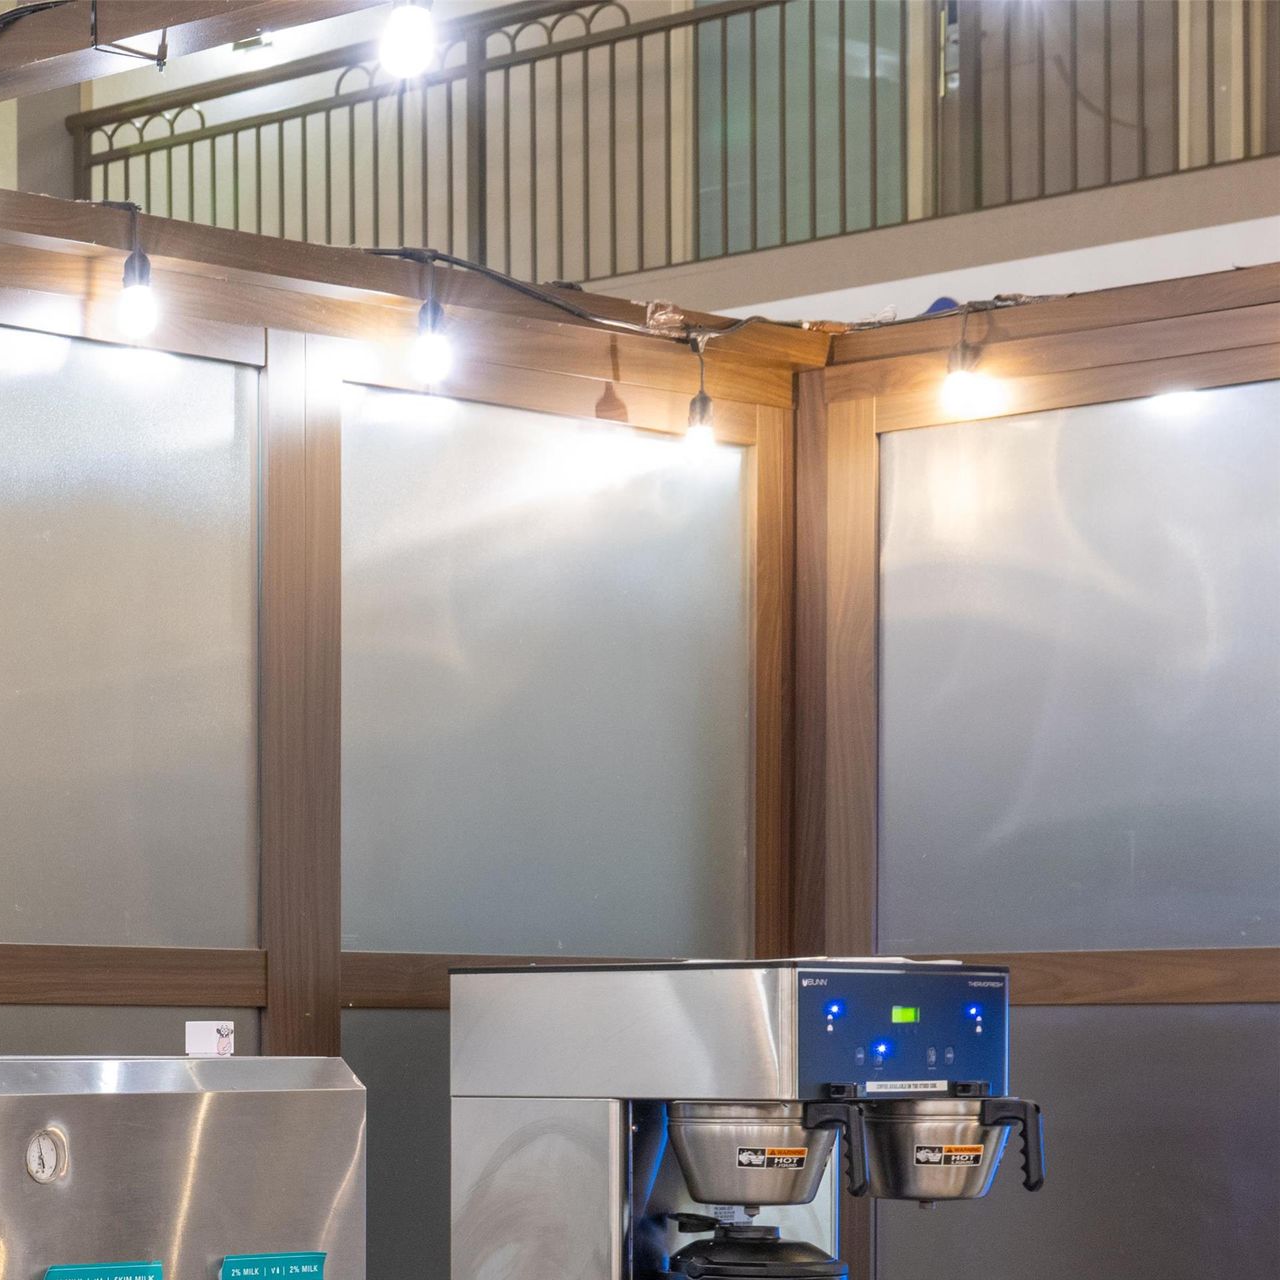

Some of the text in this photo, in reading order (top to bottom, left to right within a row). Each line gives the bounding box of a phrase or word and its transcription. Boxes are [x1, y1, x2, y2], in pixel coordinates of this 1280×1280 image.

[231, 1268, 241, 1277] 2%
[243, 1267, 259, 1276] MILK
[289, 1265, 300, 1274] 2%
[301, 1264, 318, 1273] MILK
